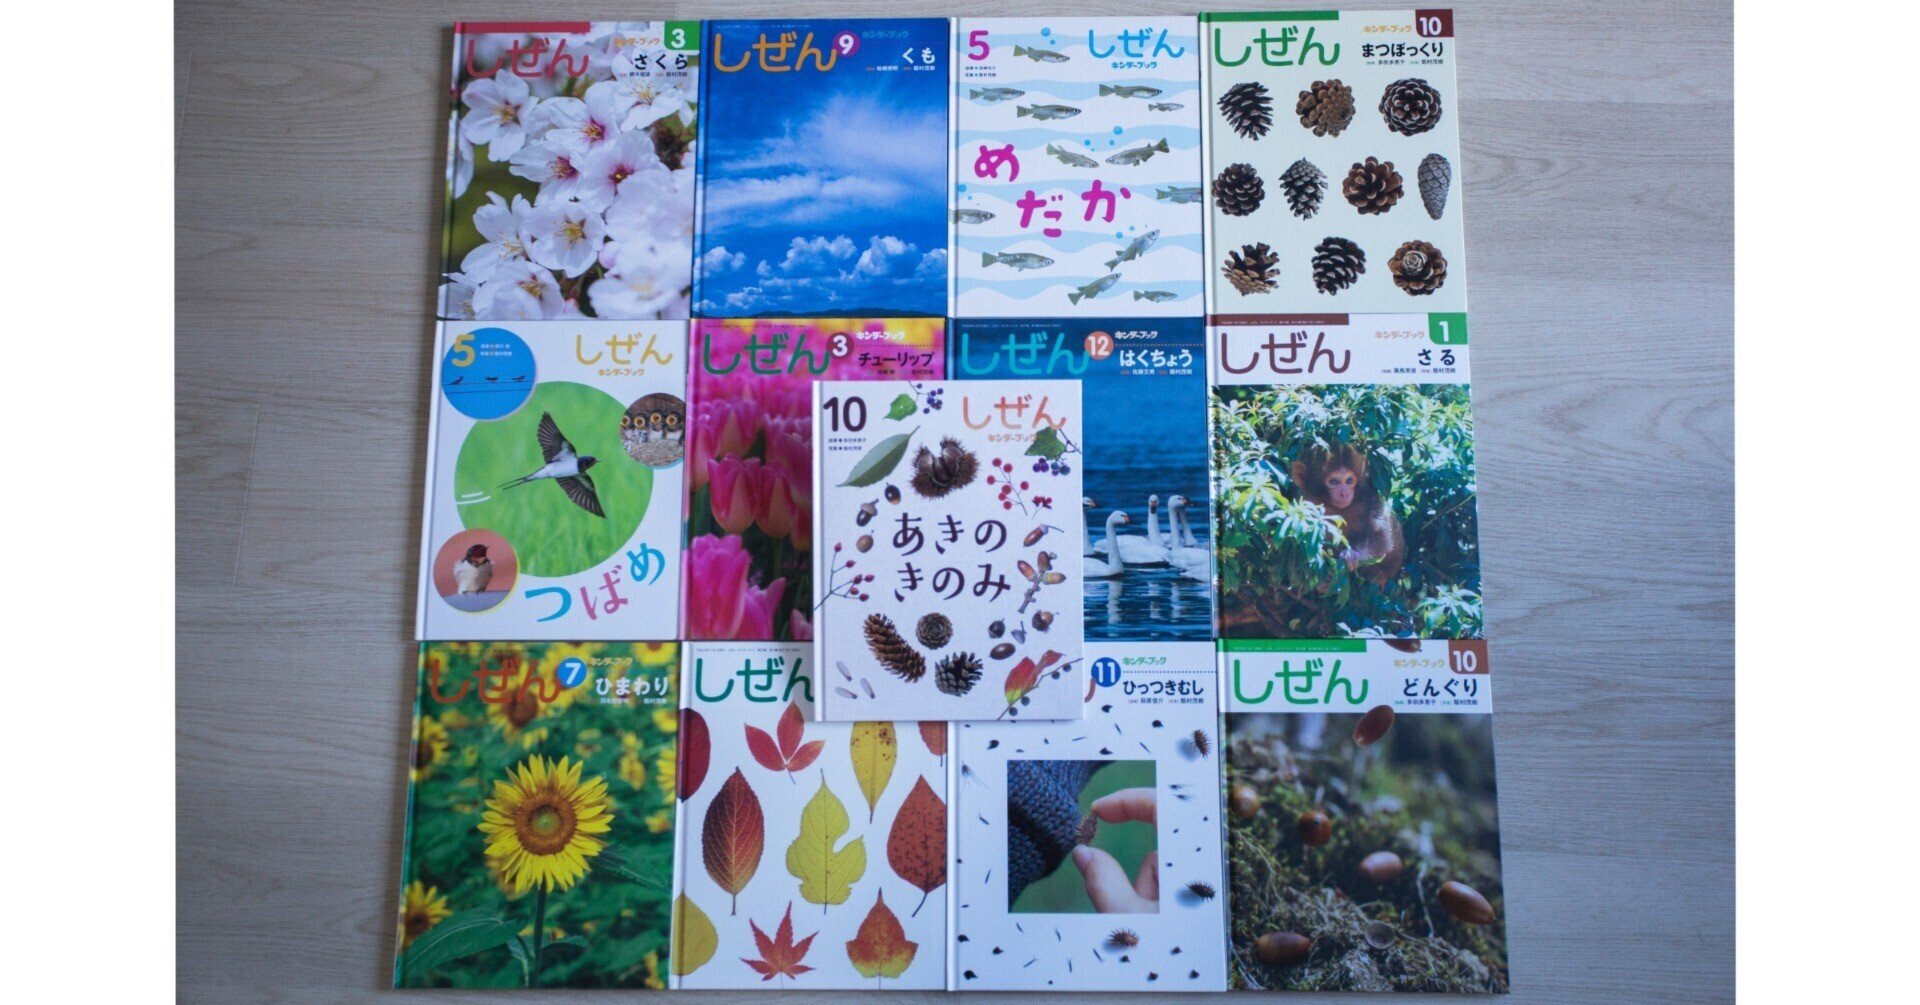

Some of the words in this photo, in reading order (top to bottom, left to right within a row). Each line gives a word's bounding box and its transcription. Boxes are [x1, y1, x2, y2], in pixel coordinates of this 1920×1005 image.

[861, 30, 909, 39] キンダーブック
[1363, 24, 1412, 33] キンダーブック
[1419, 16, 1442, 36] 10
[613, 36, 660, 47] キンダーブック
[671, 28, 686, 49] 3
[839, 34, 854, 55] 9
[968, 30, 990, 60] 5
[1088, 27, 1185, 58] しぜん
[1214, 25, 1340, 67] しぜん
[466, 38, 589, 78] しぜん
[634, 54, 688, 70] さくら
[714, 31, 837, 73] しぜん
[902, 47, 936, 64] くも
[1111, 61, 1158, 69] キンダーブック
[974, 143, 1131, 238] めだか
[856, 331, 905, 340] キンダーブック
[1114, 330, 1158, 340] キンダーブック
[1375, 330, 1425, 339] キンダーブック
[1439, 321, 1449, 342] 1
[452, 334, 476, 367] 5
[576, 332, 673, 366] しぜん
[703, 332, 829, 375] しぜん
[832, 335, 848, 357] 3
[962, 331, 1090, 375] しぜん
[1088, 336, 1110, 356] 12
[1221, 331, 1351, 374] しぜん
[858, 351, 935, 367] チューリップ
[1119, 349, 1194, 367] はくちょう
[1418, 348, 1456, 366] さる
[598, 368, 645, 377] キンダーブック
[823, 396, 867, 432] 10
[962, 393, 1067, 430] しぜん
[988, 434, 1037, 442] キンダーブック
[892, 512, 1007, 556] あきの
[524, 542, 666, 623] つばめ
[894, 562, 1011, 602] きのみ
[590, 657, 633, 666] キンダーブック
[1122, 657, 1167, 665] キンダーブック
[1393, 658, 1445, 668] キンダーブック
[1453, 650, 1477, 672] 10
[430, 657, 562, 704] しぜん
[564, 662, 581, 684] 7
[695, 656, 814, 702] しぜん
[1095, 661, 1115, 683] 11
[1234, 658, 1369, 704] しぜん
[596, 677, 668, 696] ひまわり
[1123, 680, 1204, 695] ひっつきむし
[1403, 678, 1477, 697] どんぐり
